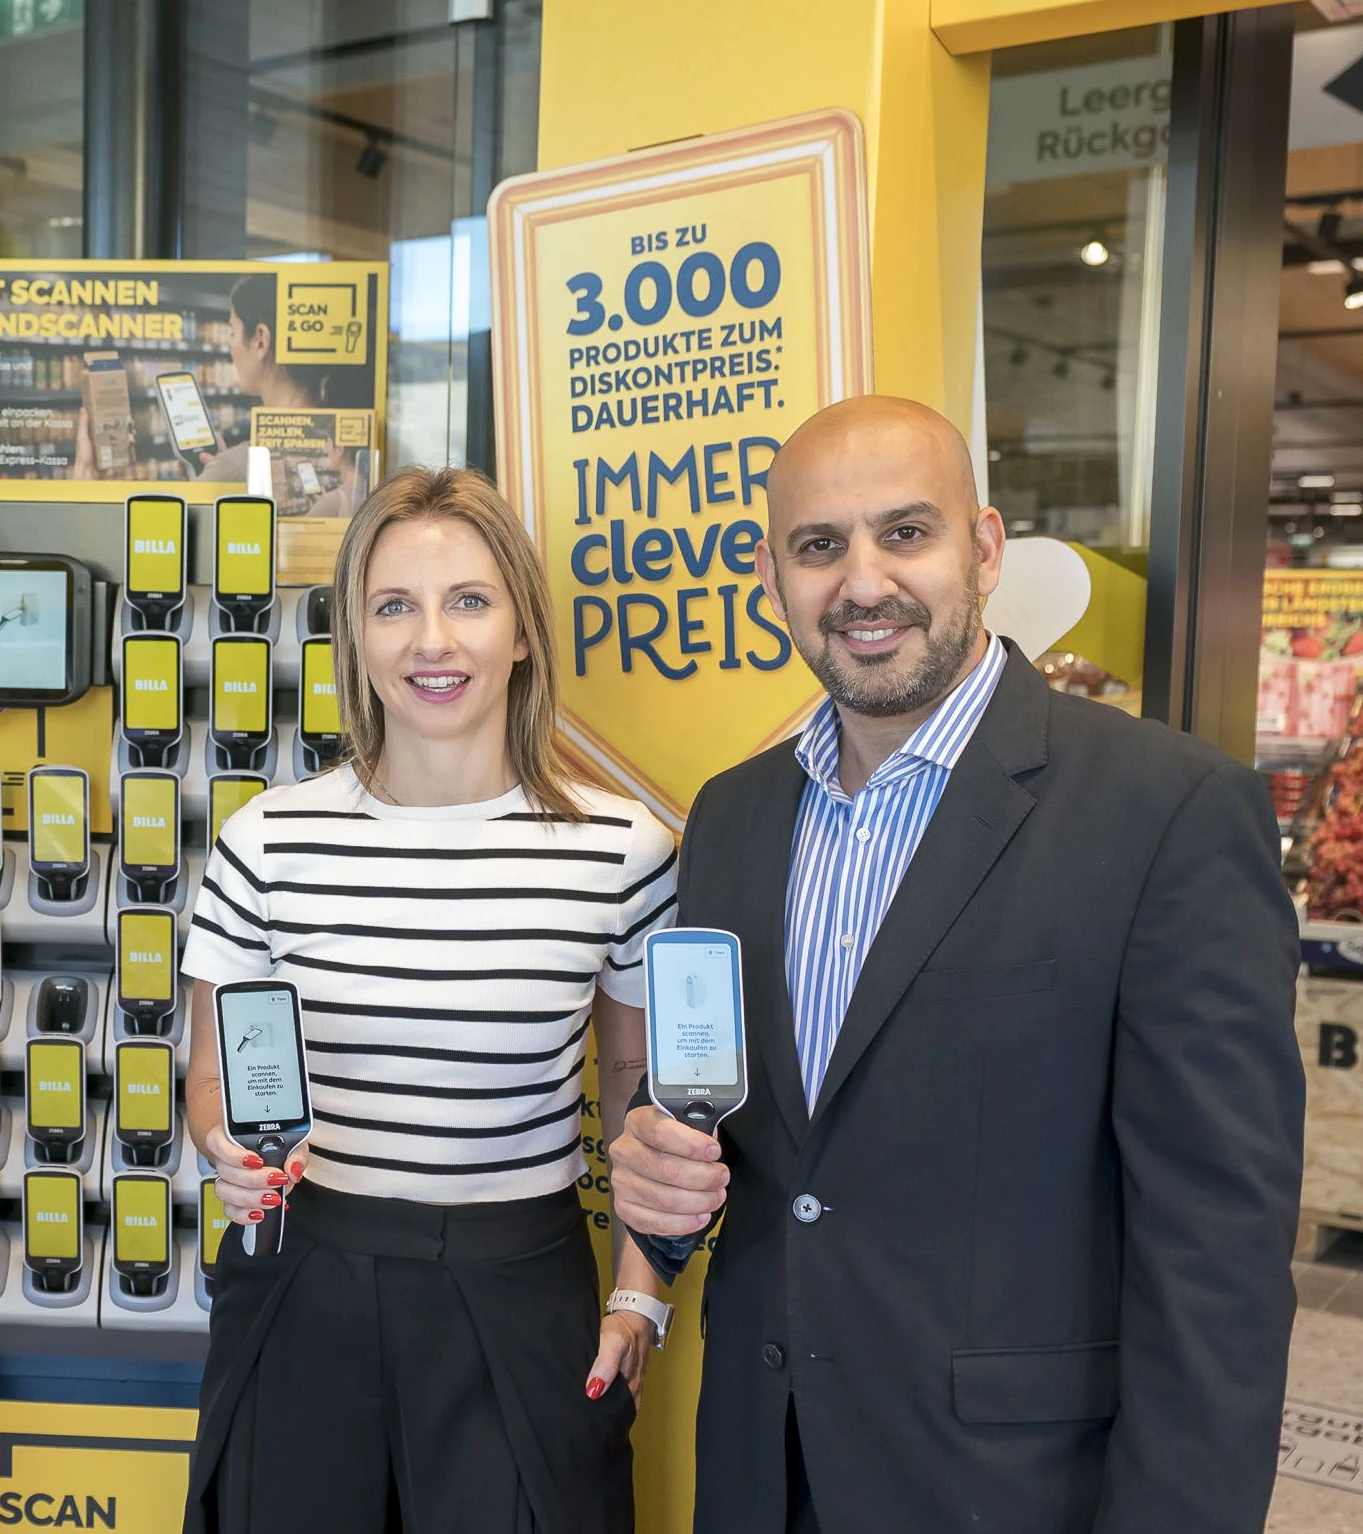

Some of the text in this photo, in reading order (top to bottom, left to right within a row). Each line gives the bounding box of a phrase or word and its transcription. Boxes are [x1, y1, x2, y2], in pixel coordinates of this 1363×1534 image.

[1059, 77, 1172, 117] Leerg
[631, 223, 707, 256] BIS ZU
[10, 279, 159, 306] SCANNEN
[565, 241, 781, 336] 3.000
[287, 303, 328, 316] SCAN
[288, 320, 324, 332] & GO
[569, 316, 783, 370] PRODUKTE ZUM
[12, 361, 32, 371] und
[572, 378, 785, 433] DAUERHAFT.
[26, 418, 43, 428] der
[573, 436, 783, 525] IMMER
[134, 539, 176, 555] BILLA
[227, 542, 261, 554] BILLA
[571, 519, 764, 586] cleve
[573, 584, 792, 680] PREIS
[134, 679, 168, 691] BILLA
[223, 681, 257, 693] BILLA
[42, 813, 75, 825] BILLA
[133, 816, 166, 828] BILLA
[130, 952, 162, 963] BILLA
[39, 1080, 72, 1092] BILLA
[127, 1083, 160, 1095] BILLA
[687, 1088, 711, 1096] ZEBRA
[259, 1123, 281, 1131] ZEBRA
[36, 1212, 69, 1224] BILLA
[125, 1215, 157, 1227] BILLA
